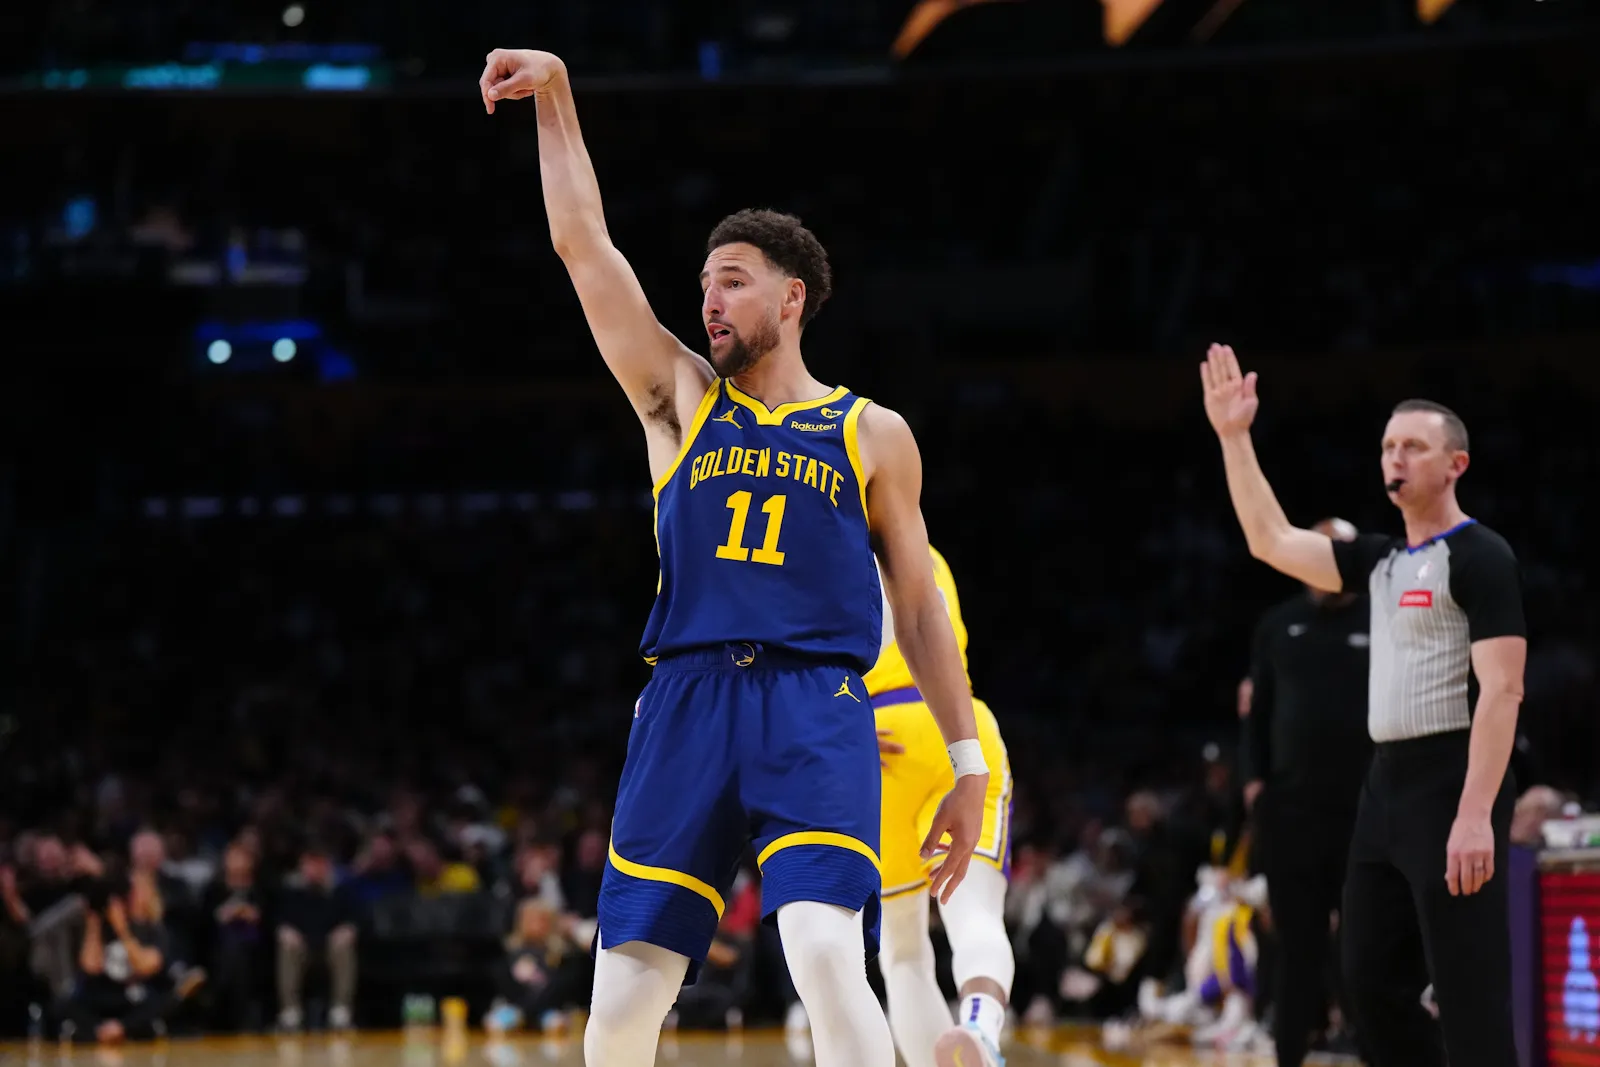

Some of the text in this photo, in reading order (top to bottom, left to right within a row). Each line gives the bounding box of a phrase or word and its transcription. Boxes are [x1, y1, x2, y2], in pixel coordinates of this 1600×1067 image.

[791, 421, 837, 431] Rakuten
[690, 446, 845, 508] GOLDEN STATE
[716, 491, 787, 566] 11
